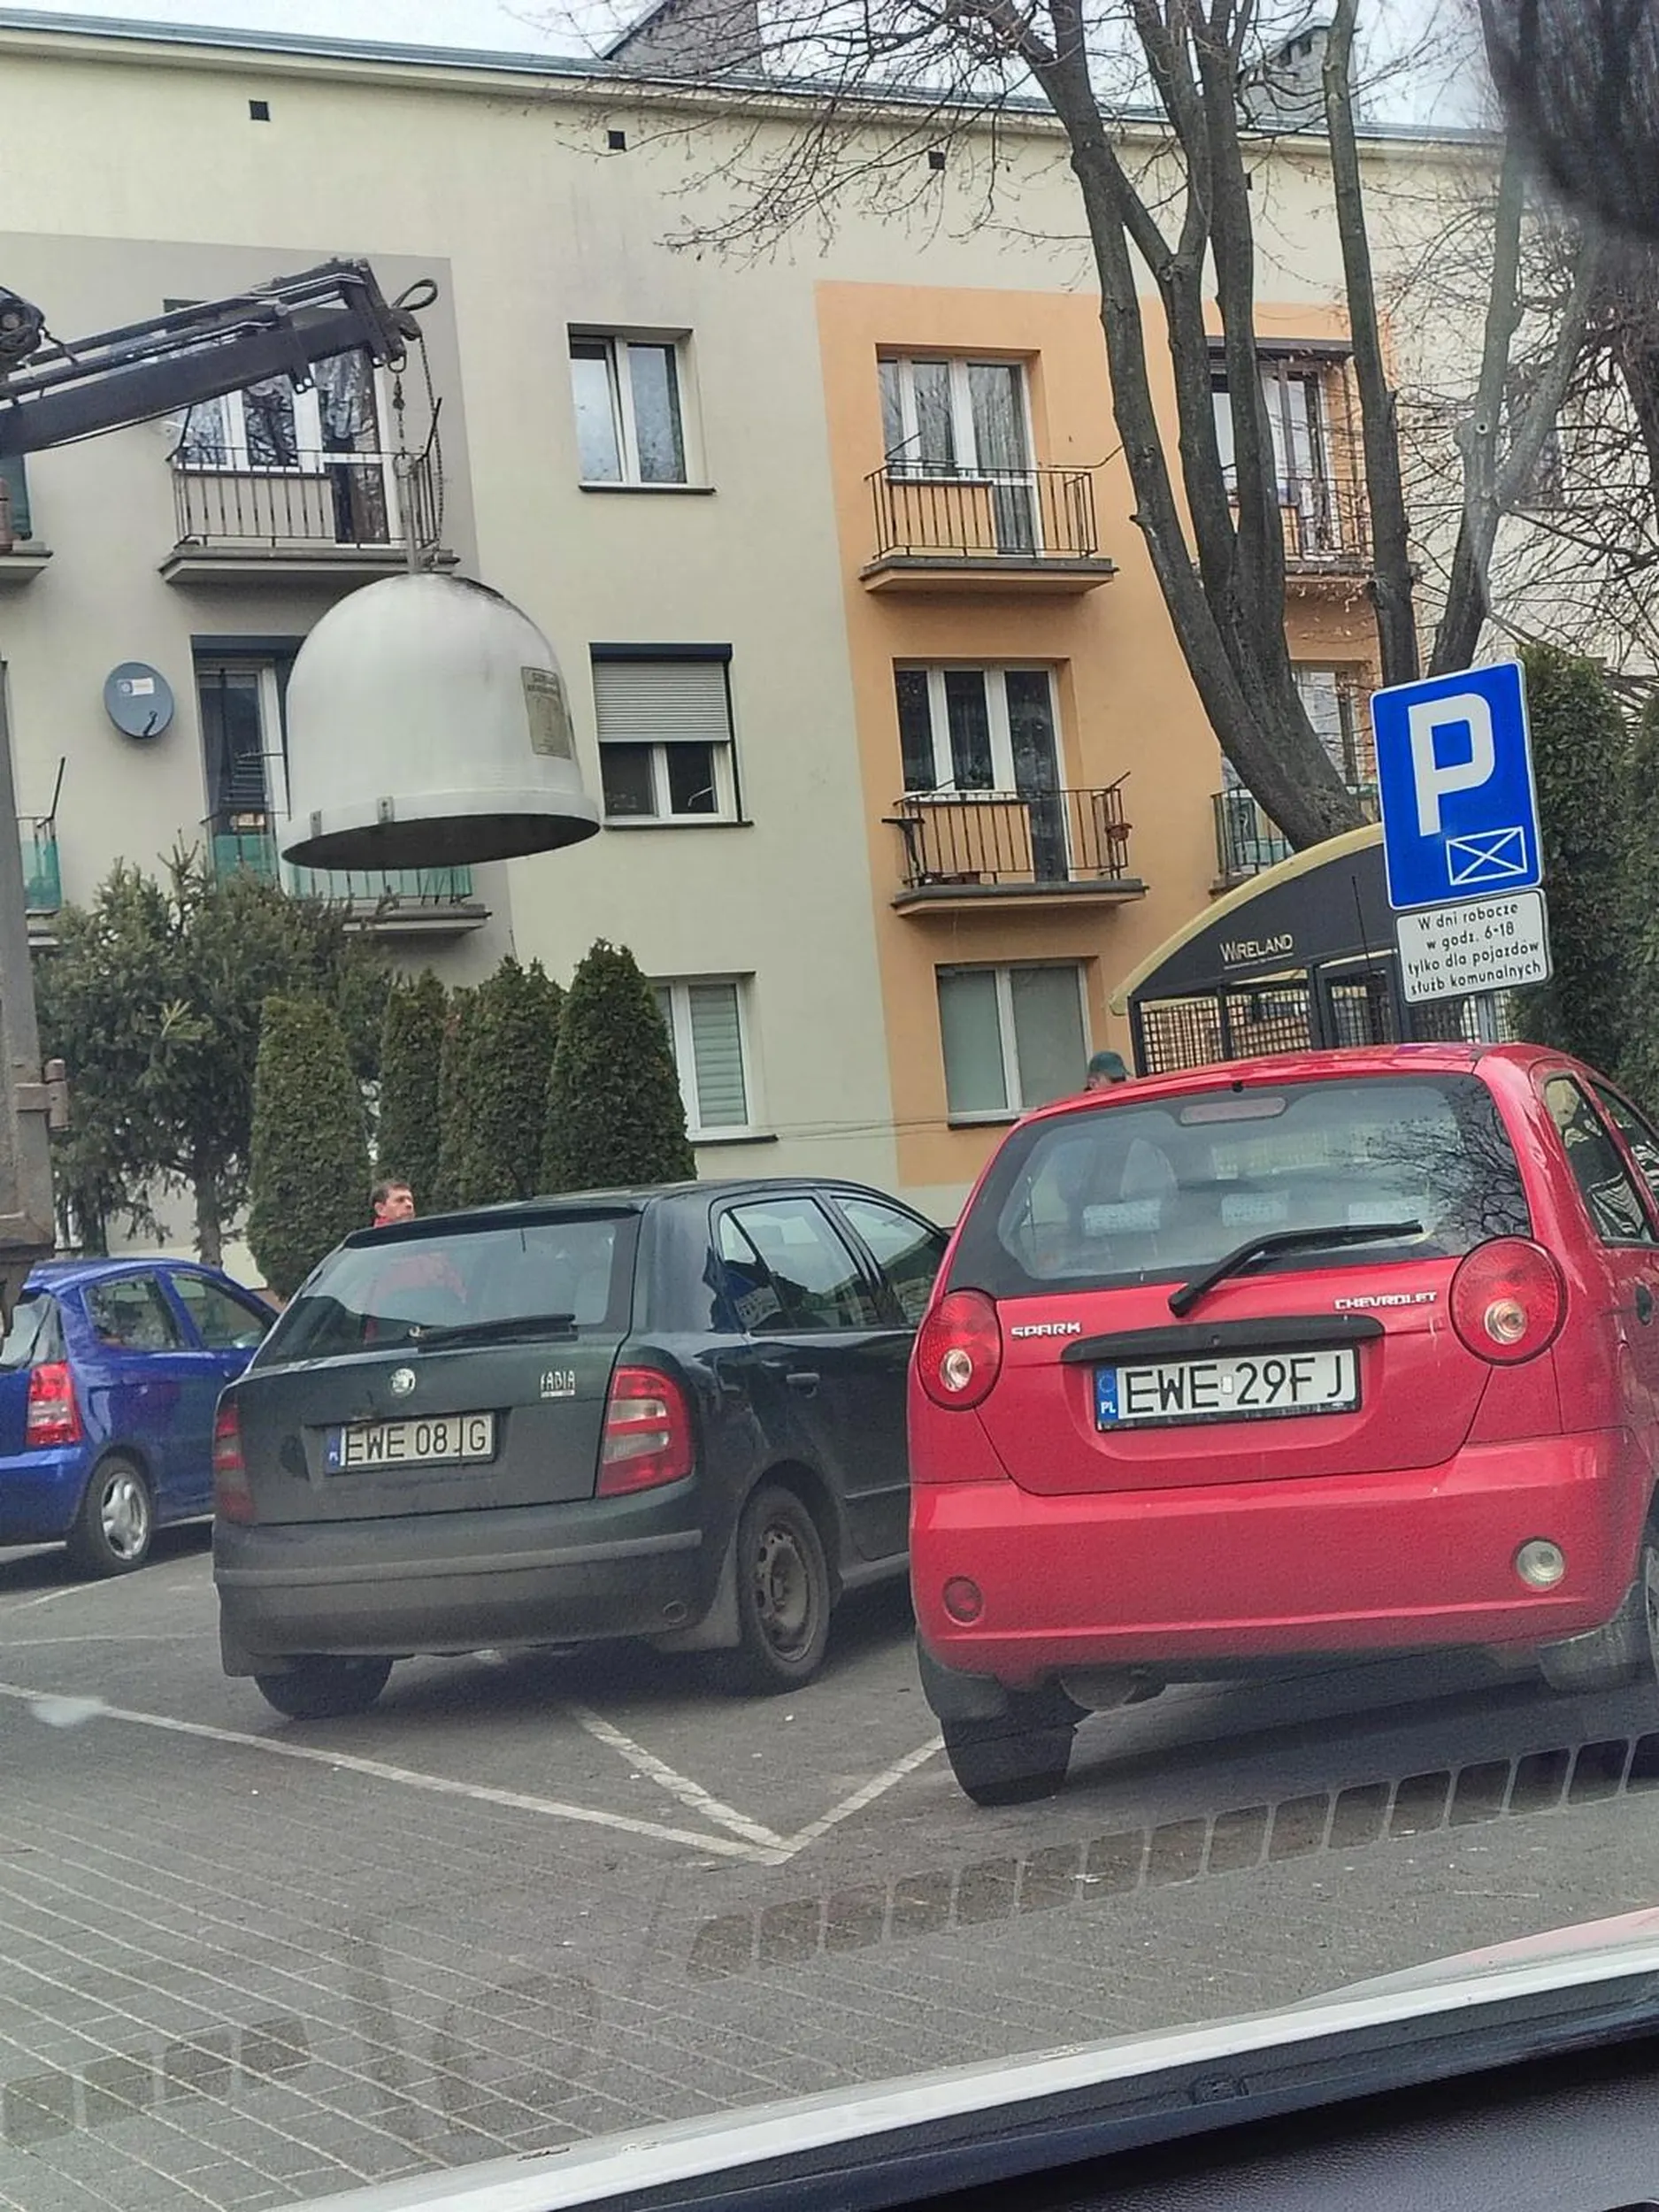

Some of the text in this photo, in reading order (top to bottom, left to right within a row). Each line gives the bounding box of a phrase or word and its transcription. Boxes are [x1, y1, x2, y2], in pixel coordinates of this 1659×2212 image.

[1408, 693, 1495, 837] P
[1417, 903, 1518, 930] W dni robocze
[1219, 934, 1294, 963] WIRELAND
[1426, 921, 1515, 951] w godz. 6-18
[1408, 939, 1539, 978] tylko dla pojazdów
[1451, 960, 1541, 987] komunalnych
[1334, 1292, 1437, 1310] CHEVROLET
[1011, 1323, 1081, 1338] SPARK
[541, 1371, 575, 1390] FABIA
[1125, 1364, 1219, 1413] EWE
[1101, 1402, 1116, 1414] PL
[346, 1426, 404, 1462] EWE
